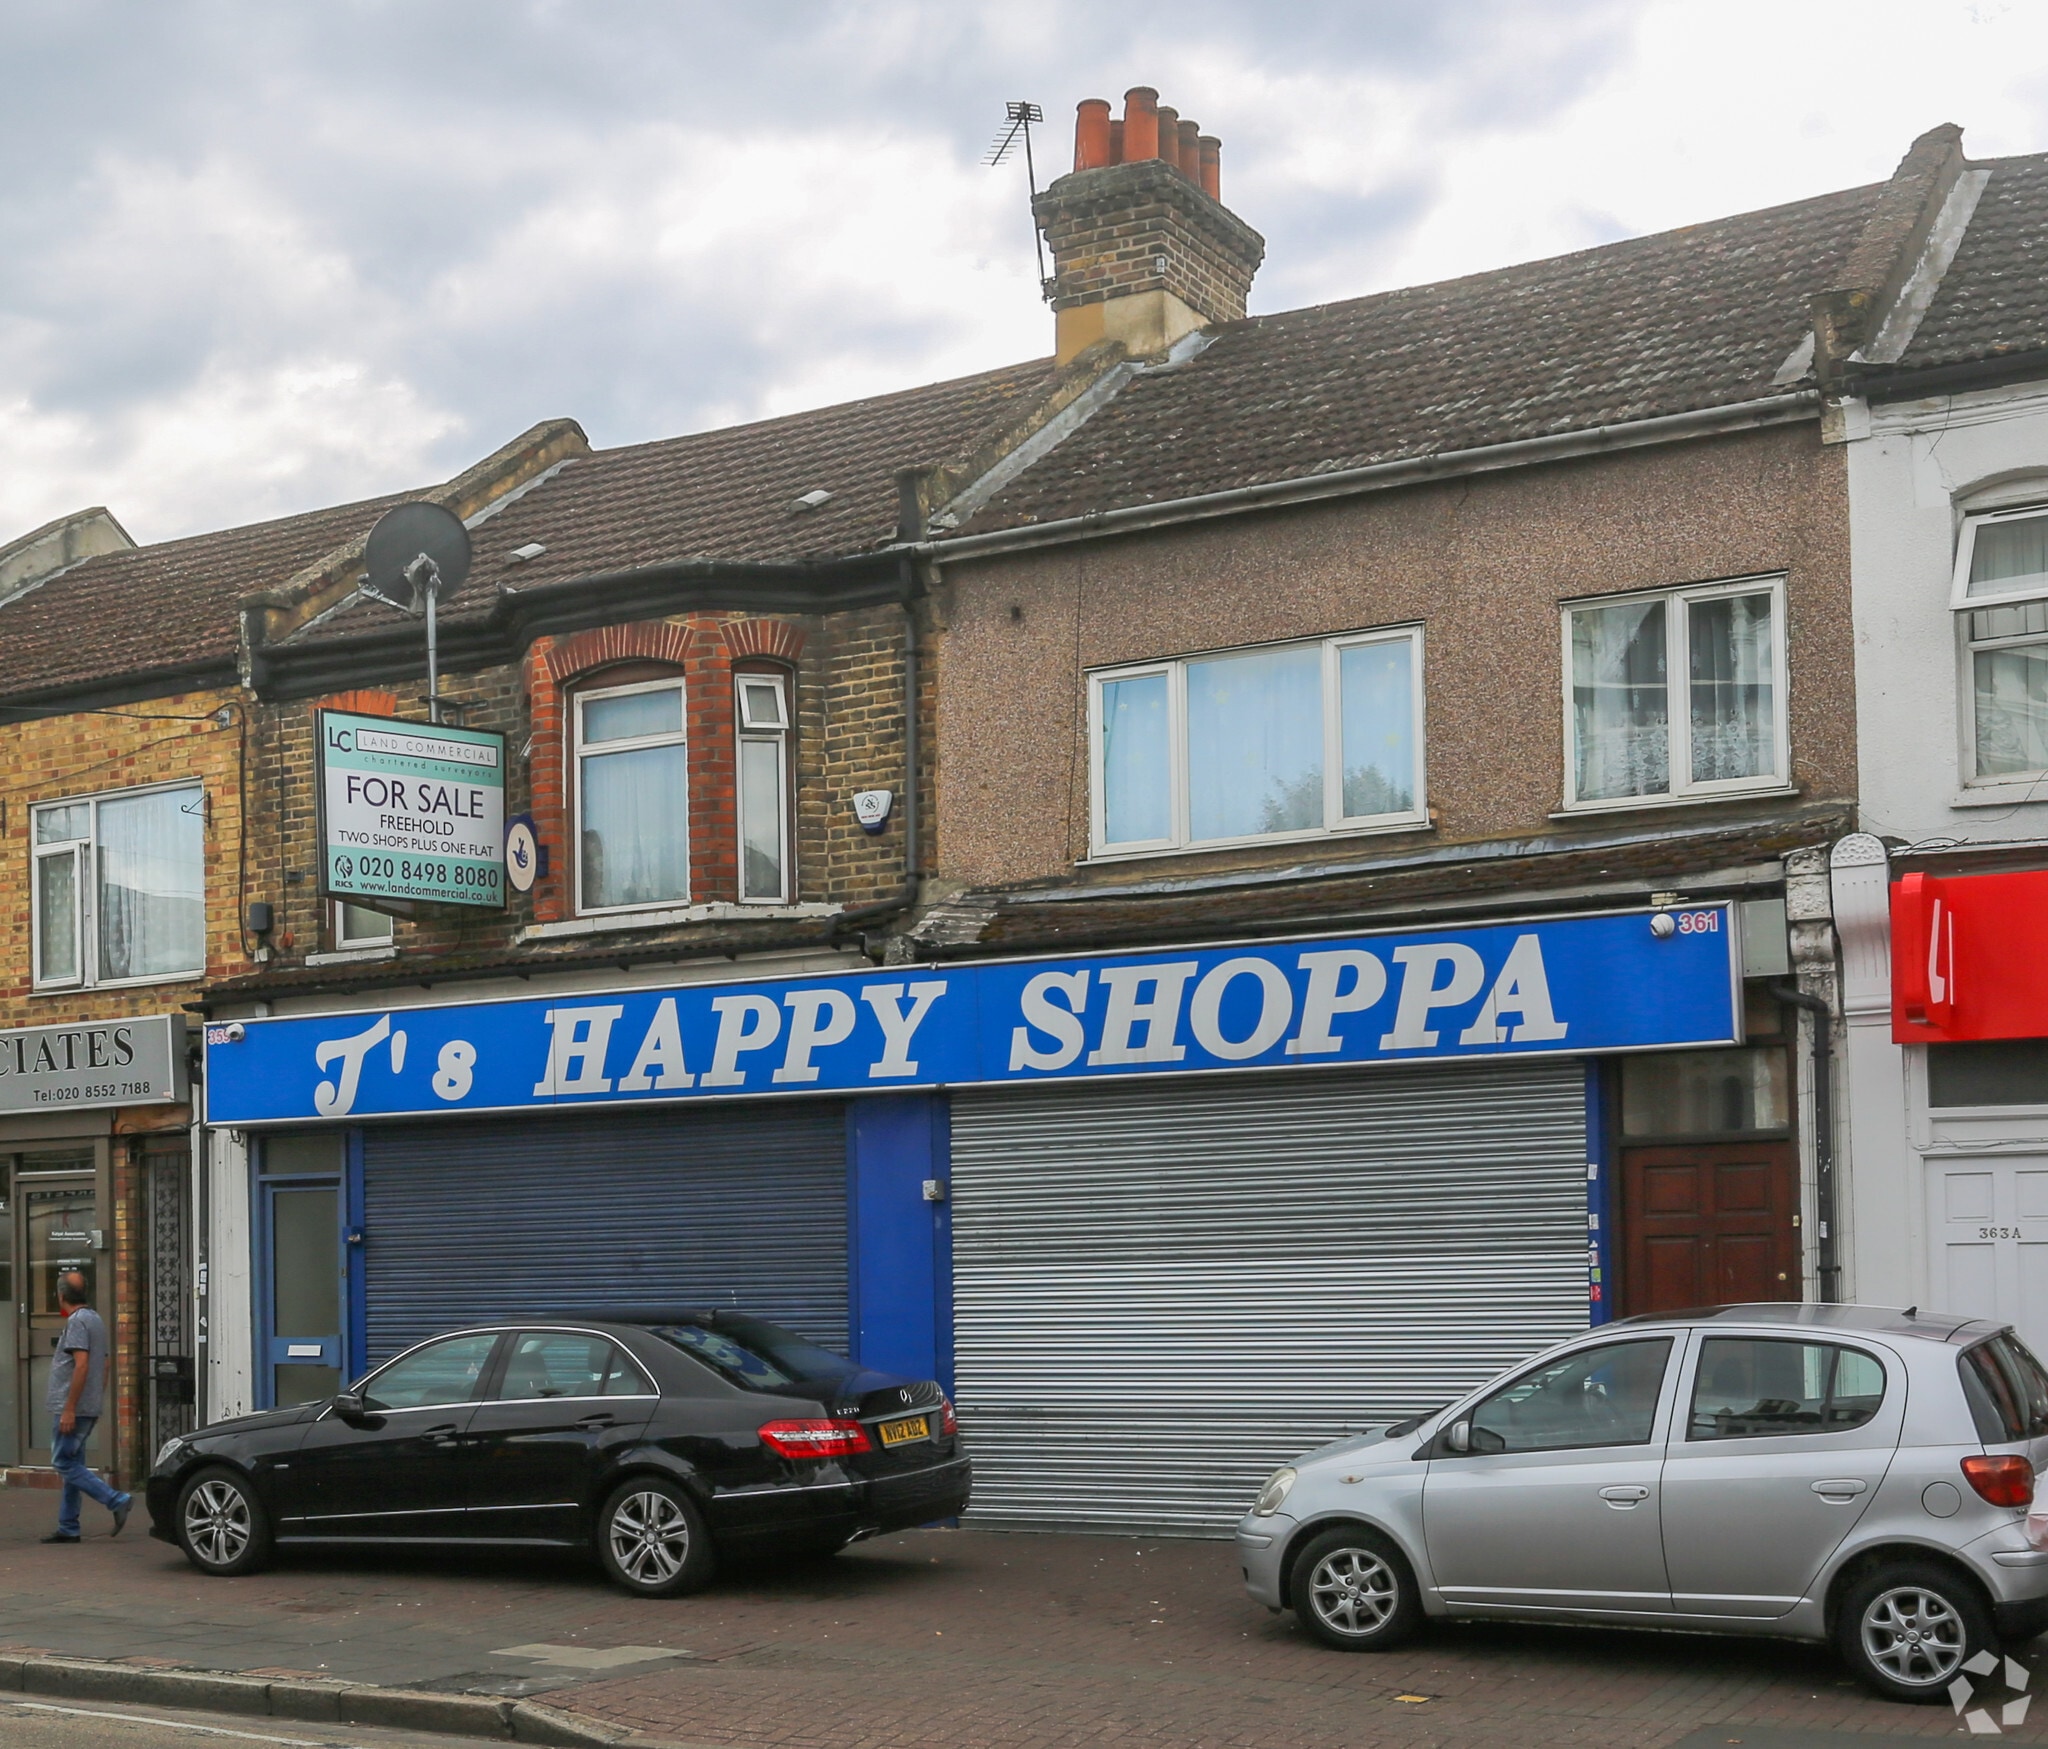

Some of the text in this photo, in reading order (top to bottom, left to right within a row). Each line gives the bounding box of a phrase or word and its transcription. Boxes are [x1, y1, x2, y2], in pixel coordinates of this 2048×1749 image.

[328, 726, 352, 753] LC
[363, 736, 491, 762] LAND COMMERCIAL
[364, 755, 492, 778] chartered surveyors
[346, 775, 484, 819] FOR SALE
[380, 814, 454, 836] FREEHOLD
[338, 830, 494, 857] TWO SHOPS PLUS ONE FLAT
[359, 856, 498, 888] 020 8498 8080
[335, 880, 353, 889] RICS
[360, 881, 498, 902] www.landcommercial.co.uk
[1679, 911, 1718, 934] 361
[533, 980, 947, 1097] HAPPY
[1008, 934, 1568, 1072] SHOPPA
[34, 1081, 150, 1101] Tel:020 8552 7188
[1979, 1226, 2022, 1239] 363A
